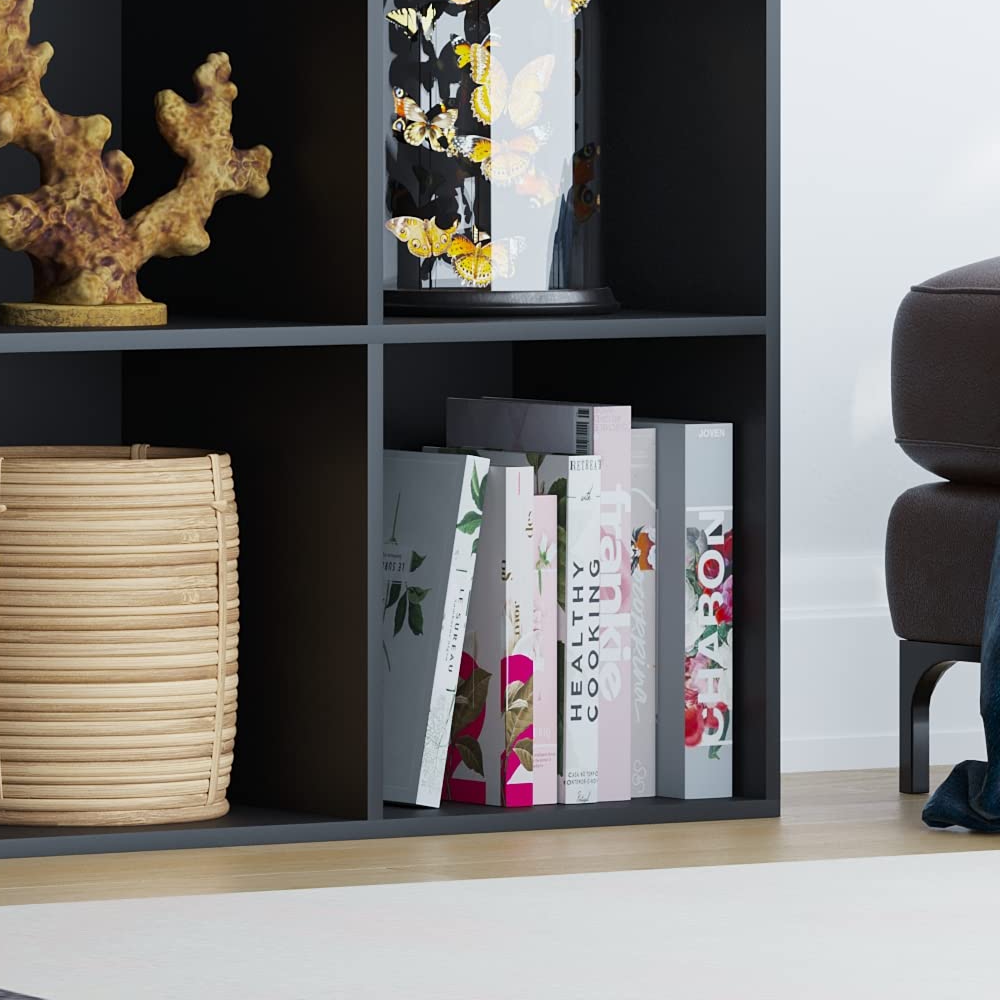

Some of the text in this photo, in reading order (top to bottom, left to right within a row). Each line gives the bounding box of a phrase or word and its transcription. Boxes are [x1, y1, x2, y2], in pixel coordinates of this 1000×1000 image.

[448, 612, 462, 673] SUREAU
[570, 562, 584, 722] HEALTHY
[587, 559, 601, 723] COOKING
[600, 484, 632, 701] frankie
[697, 511, 726, 745] CHABON
